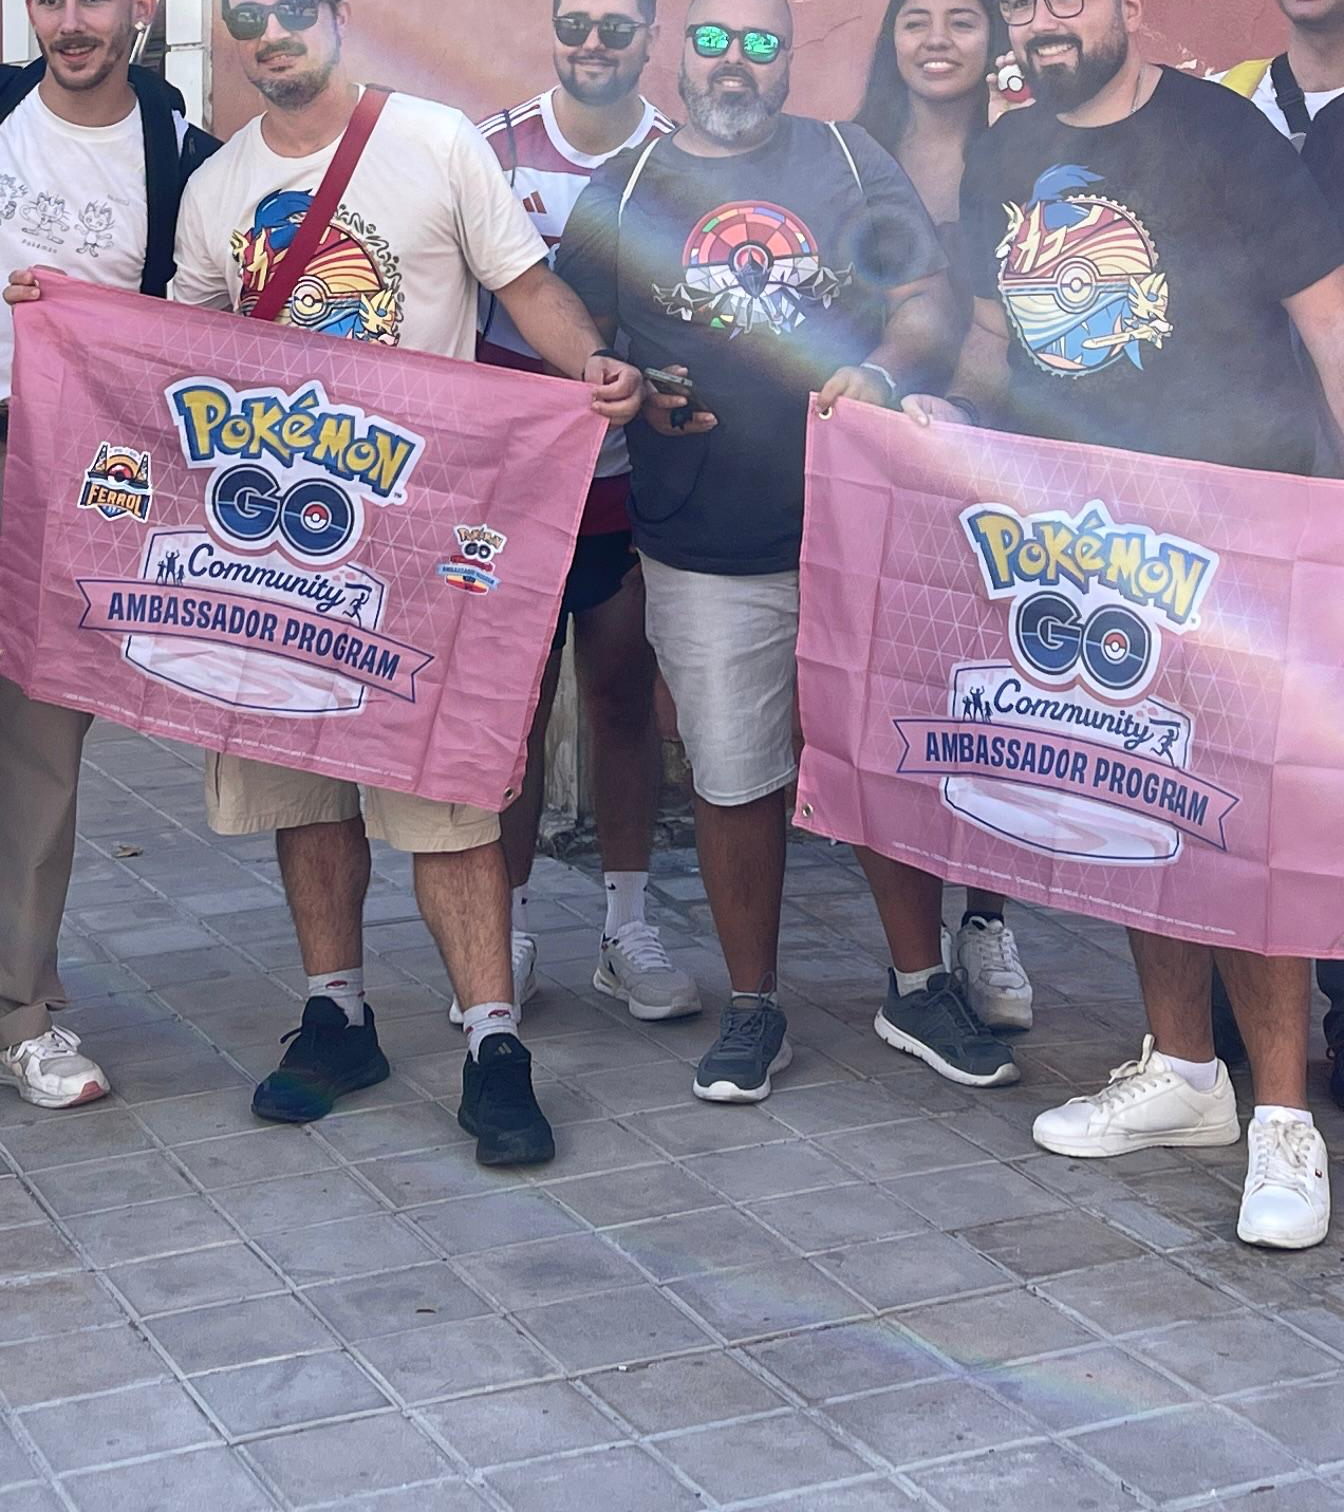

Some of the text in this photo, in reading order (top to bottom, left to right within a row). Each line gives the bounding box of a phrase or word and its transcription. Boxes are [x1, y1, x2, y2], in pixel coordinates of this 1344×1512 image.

[172, 384, 416, 496] Pokémon
[87, 484, 142, 517] FERROL
[212, 463, 354, 556] GO
[188, 544, 347, 611] Community
[965, 508, 1210, 623] Pokémon
[108, 592, 400, 681] AMBASSADOR PROGRAM
[1016, 590, 1151, 690] GO
[993, 678, 1154, 749] Community
[926, 732, 1209, 826] AMBASSADOR PROGRAM
